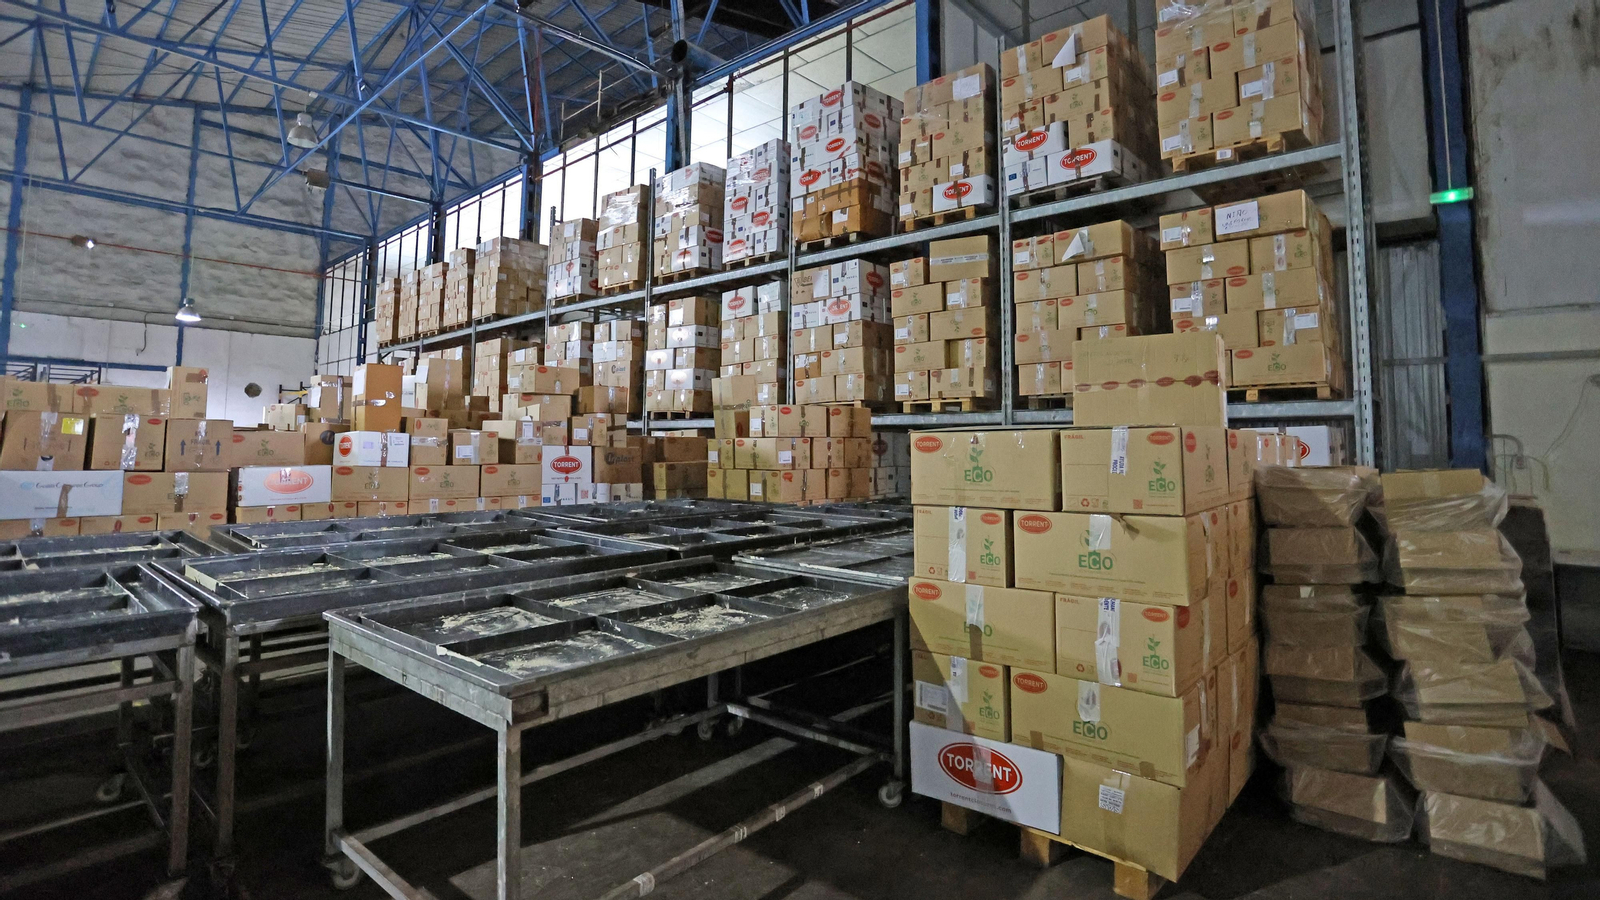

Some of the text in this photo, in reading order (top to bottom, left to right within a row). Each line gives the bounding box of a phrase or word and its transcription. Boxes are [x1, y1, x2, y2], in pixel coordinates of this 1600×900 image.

[916, 440, 940, 448] TORRENT
[964, 469, 993, 482] ECO
[1149, 478, 1176, 491] ECO
[1021, 519, 1049, 528] TORRENT
[980, 553, 1001, 565] ECO
[1078, 551, 1113, 570] ECO
[915, 587, 939, 595] TORRENT
[1143, 655, 1169, 670] ECO
[1016, 677, 1044, 689] TORRENT
[979, 707, 1000, 719] ECO
[1073, 720, 1108, 740] ECO
